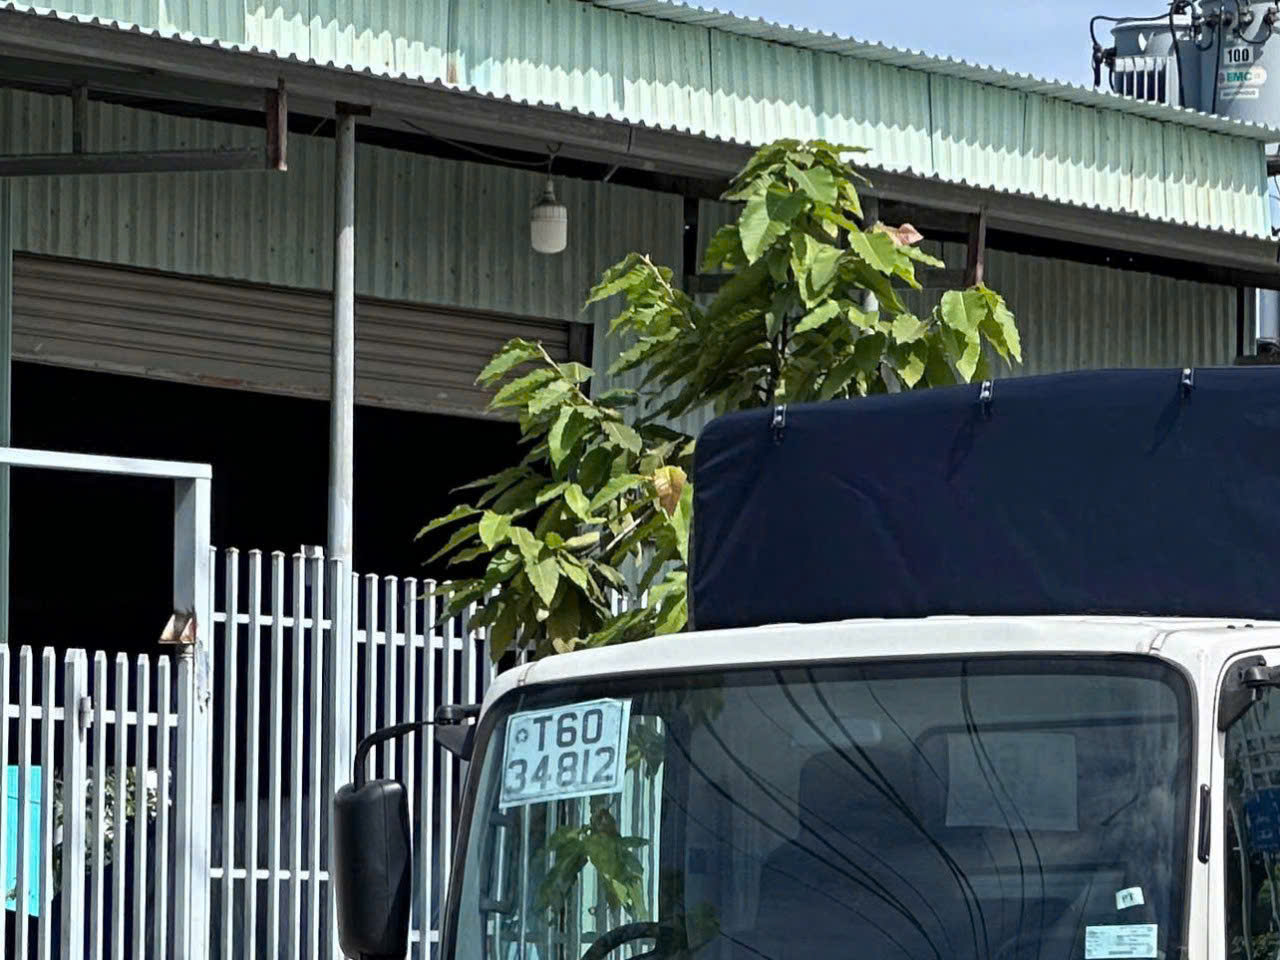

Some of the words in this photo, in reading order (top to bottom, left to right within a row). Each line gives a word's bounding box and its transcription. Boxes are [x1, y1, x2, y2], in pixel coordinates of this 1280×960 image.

[1227, 48, 1250, 63] 100
[1226, 71, 1252, 82] EMC
[533, 708, 604, 752] T60
[505, 746, 616, 794] 34812
